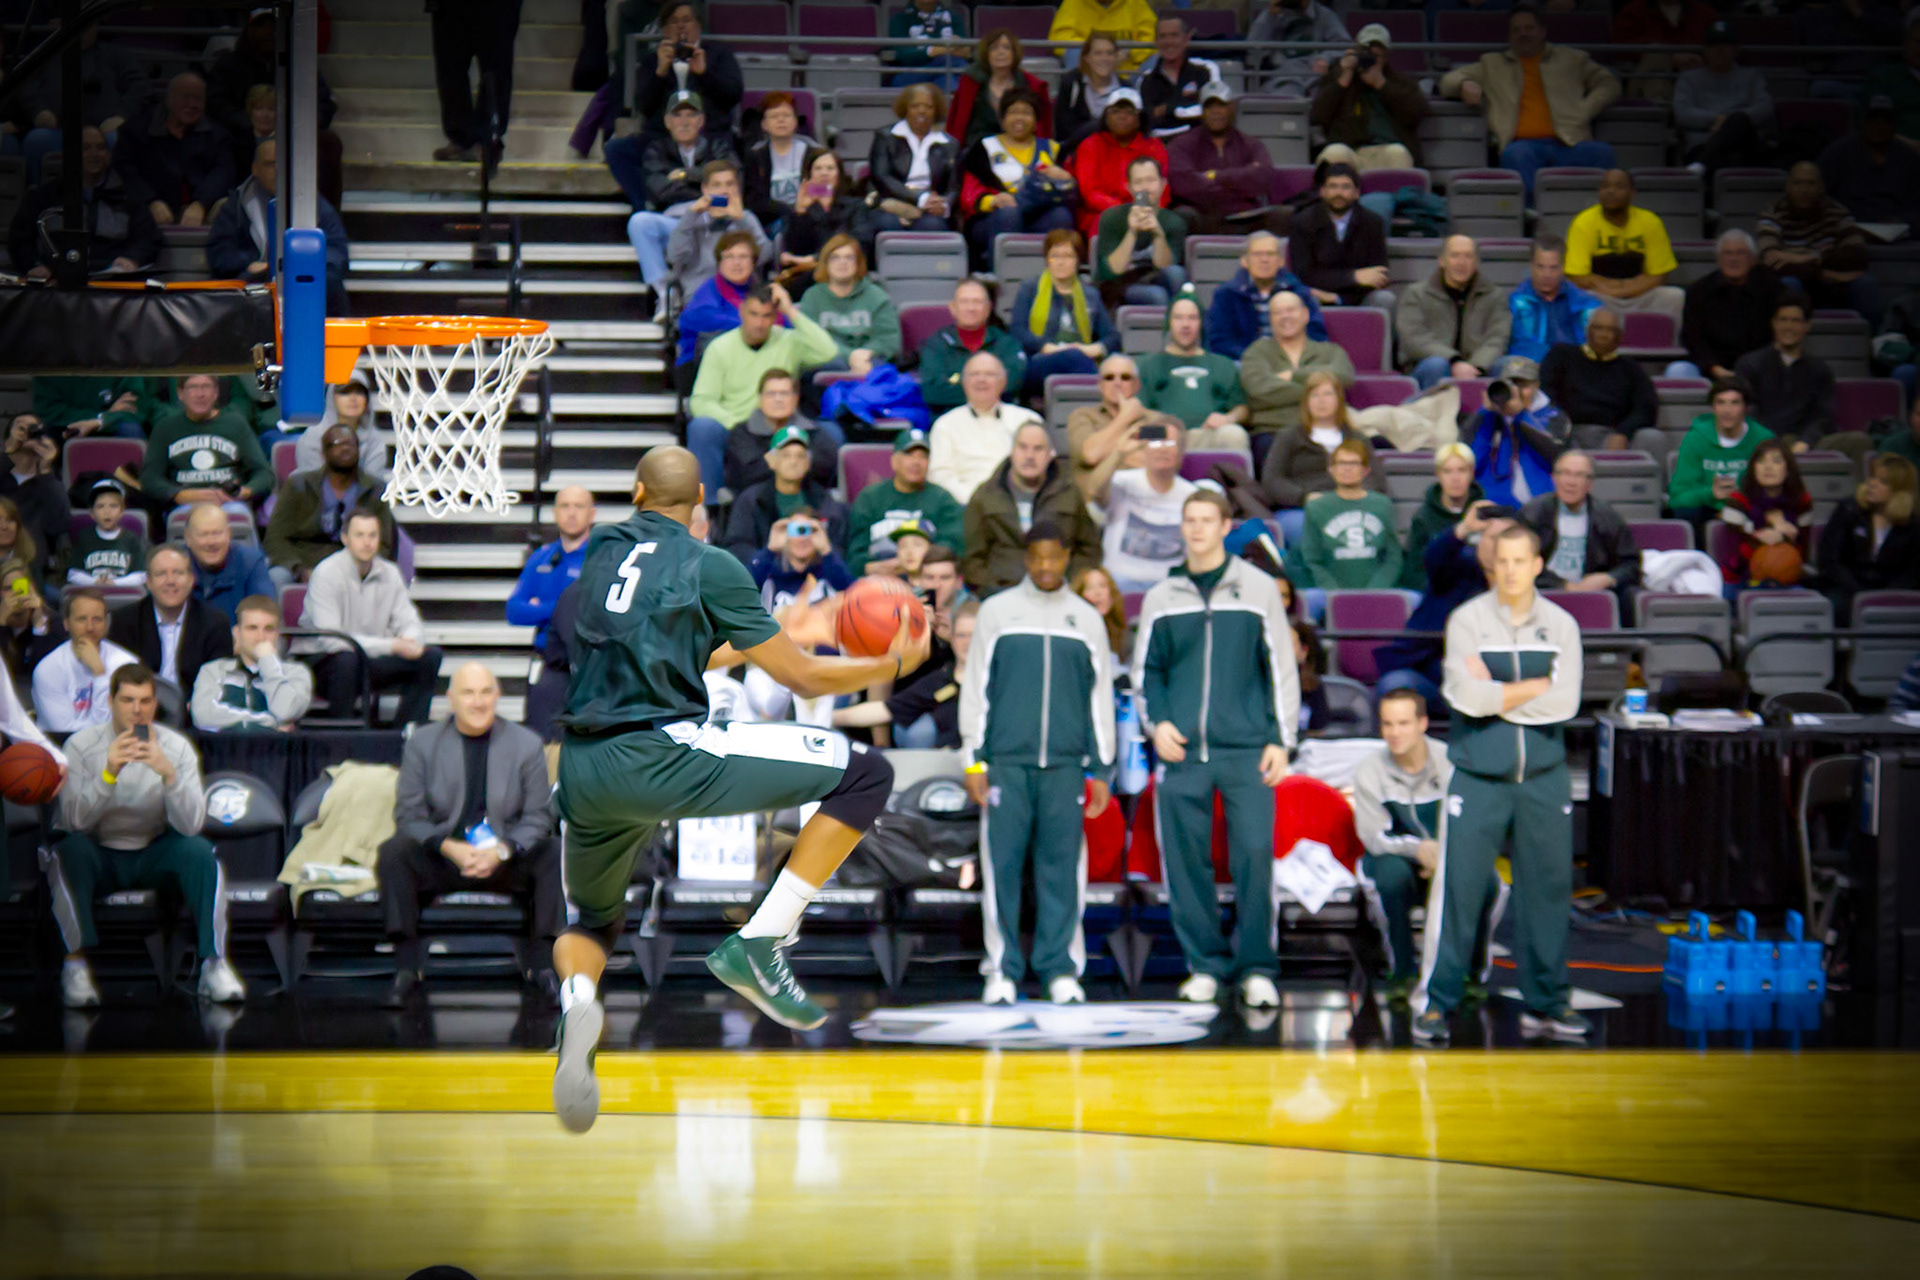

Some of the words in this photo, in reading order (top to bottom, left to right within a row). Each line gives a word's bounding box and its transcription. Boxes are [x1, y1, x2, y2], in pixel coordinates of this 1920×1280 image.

[168, 434, 210, 459] MICHIGAN
[211, 434, 237, 461] STATE
[605, 541, 658, 614] 5
